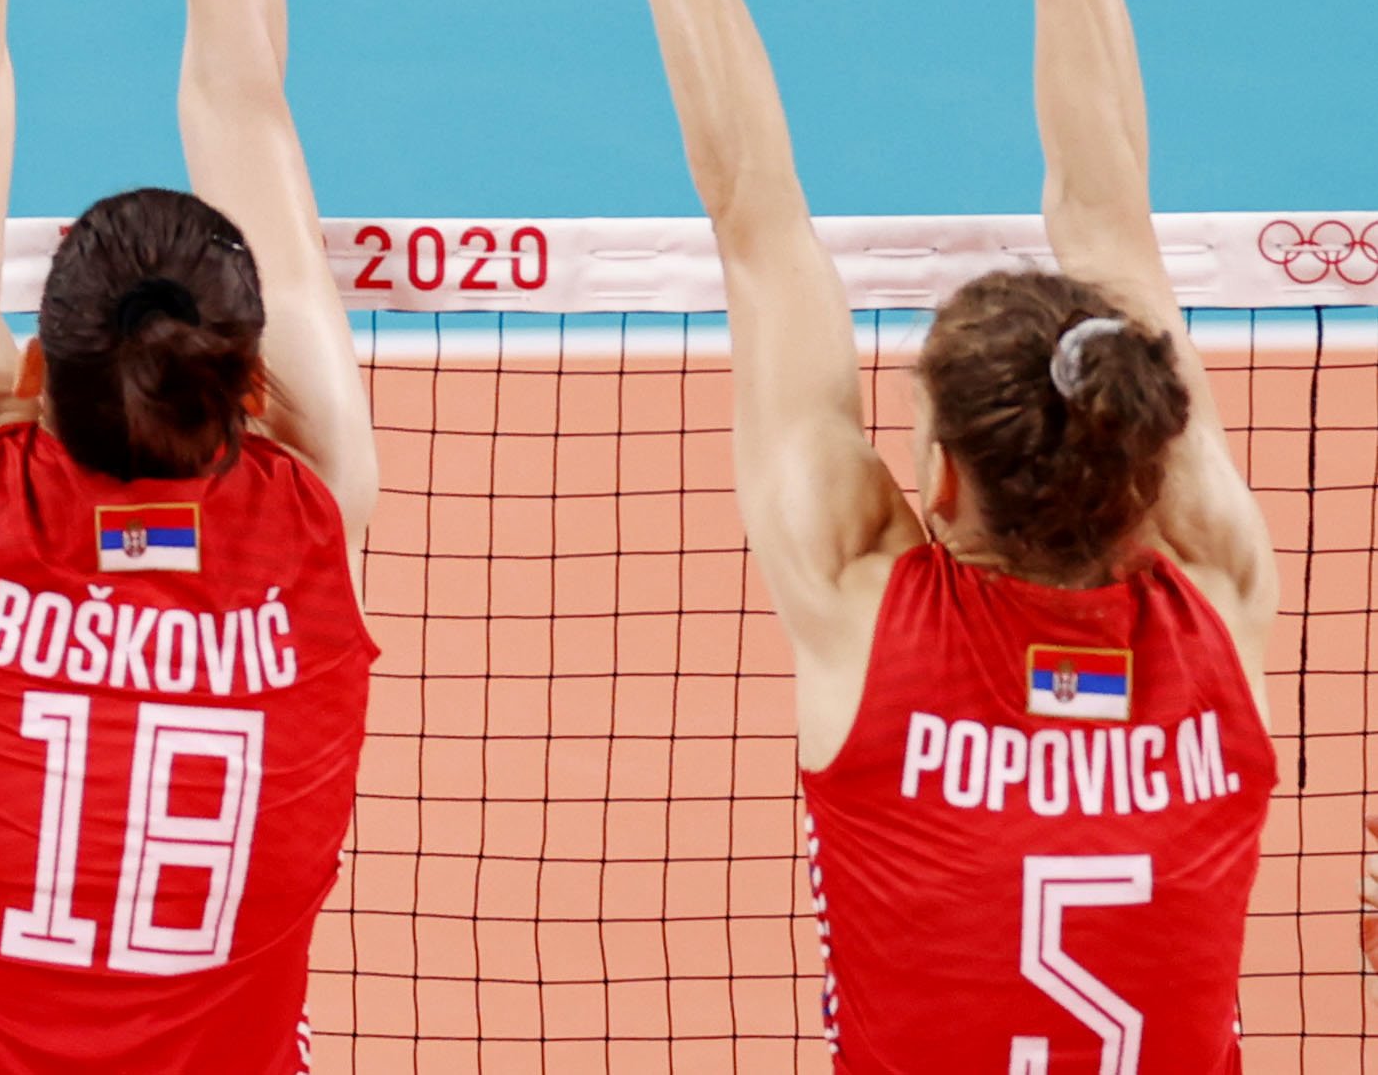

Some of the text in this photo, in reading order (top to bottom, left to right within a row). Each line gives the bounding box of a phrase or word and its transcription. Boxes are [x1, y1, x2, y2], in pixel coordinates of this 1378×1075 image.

[353, 225, 547, 291] 2020
[0, 690, 265, 976] 18
[900, 710, 1241, 816] POPOVIC M.
[1009, 854, 1153, 1075] 5
